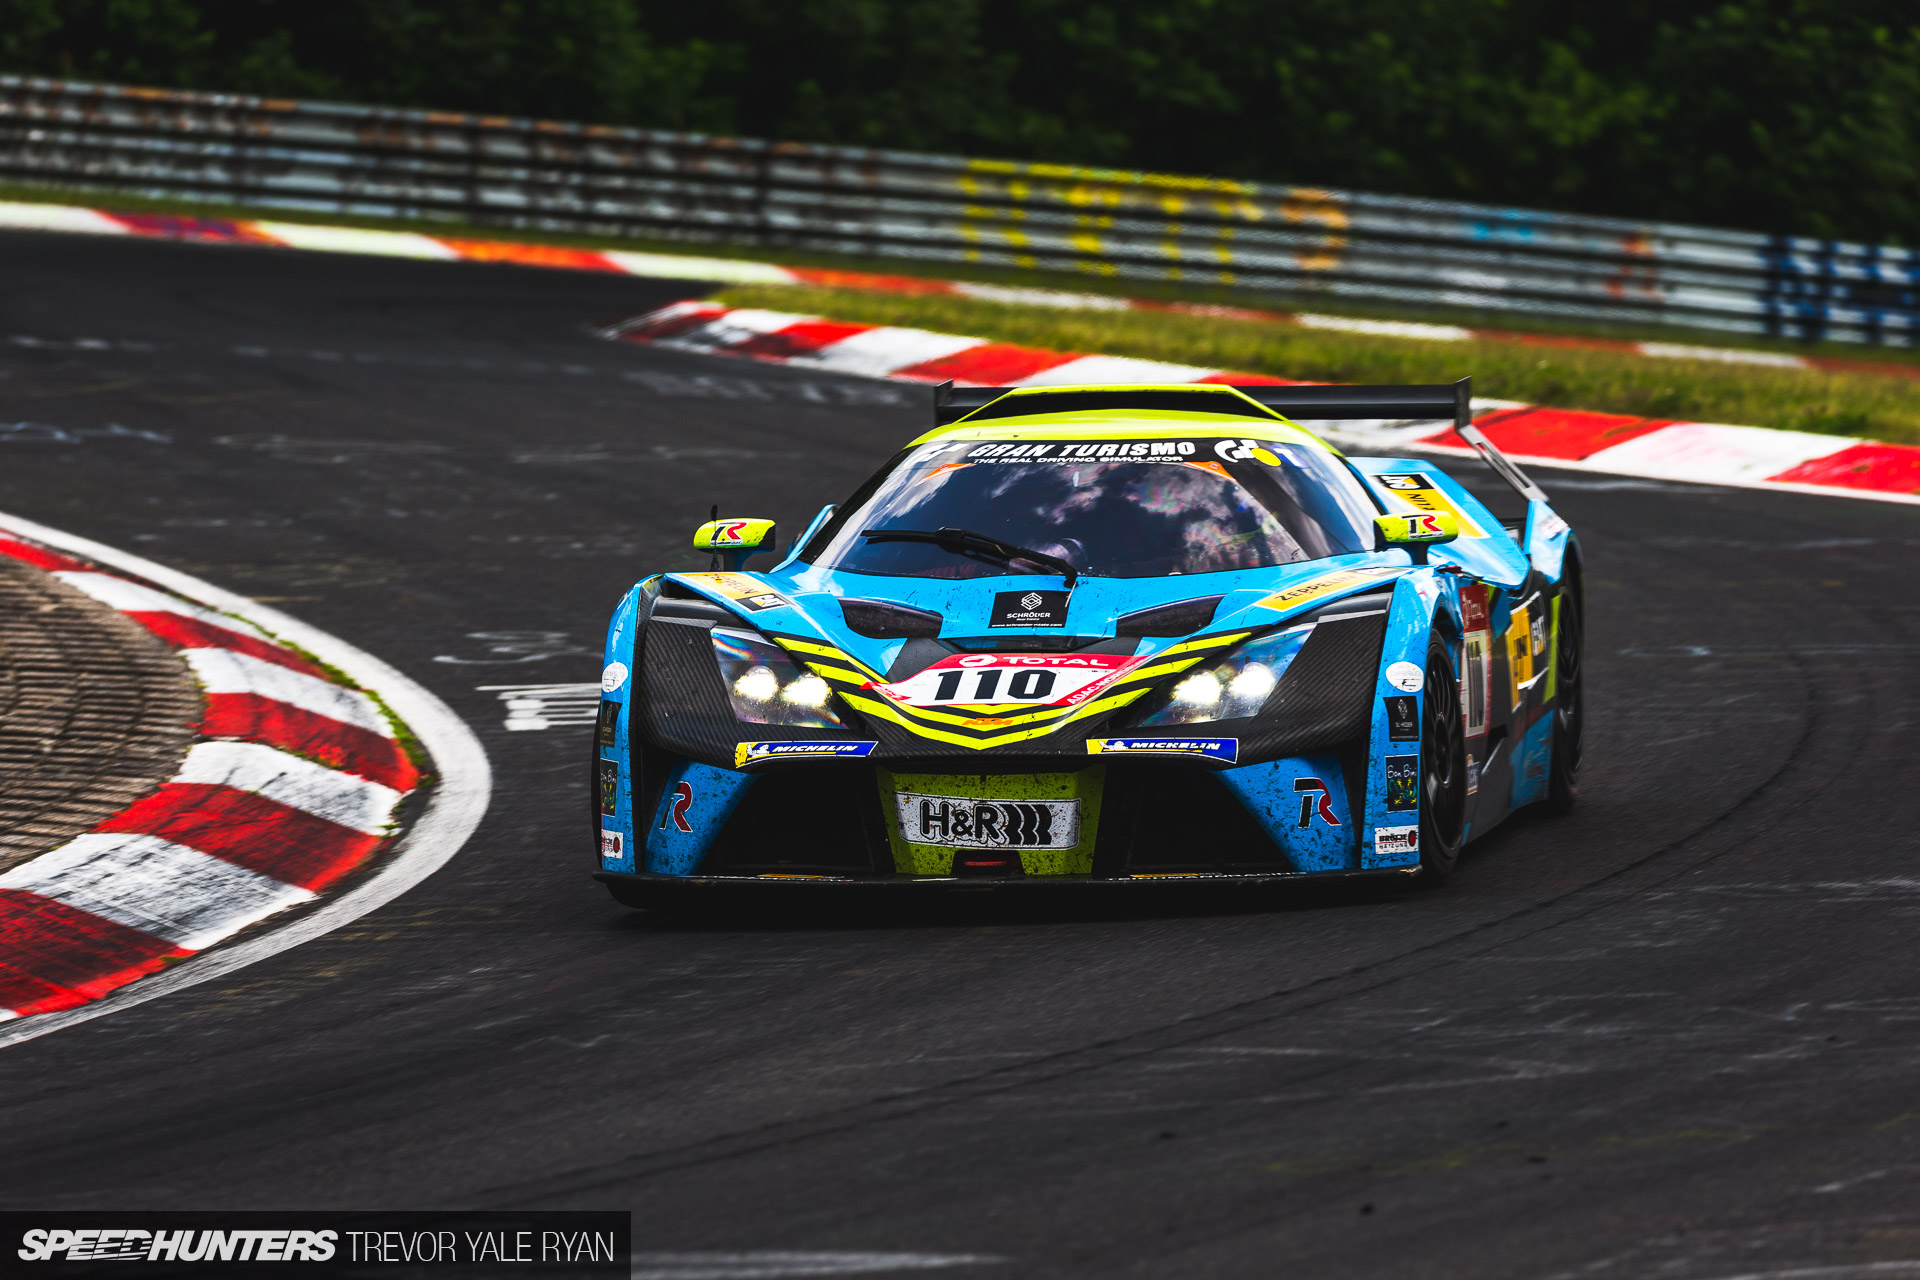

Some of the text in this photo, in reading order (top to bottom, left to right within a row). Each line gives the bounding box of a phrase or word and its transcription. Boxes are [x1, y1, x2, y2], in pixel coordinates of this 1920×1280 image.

[967, 441, 1196, 458] GRAN TURISMO
[1003, 656, 1109, 667] TOTAL
[934, 670, 1057, 701] 110
[772, 745, 859, 753] MICHELIN
[1131, 742, 1221, 751] MICHELIN
[920, 800, 1002, 841] H&R
